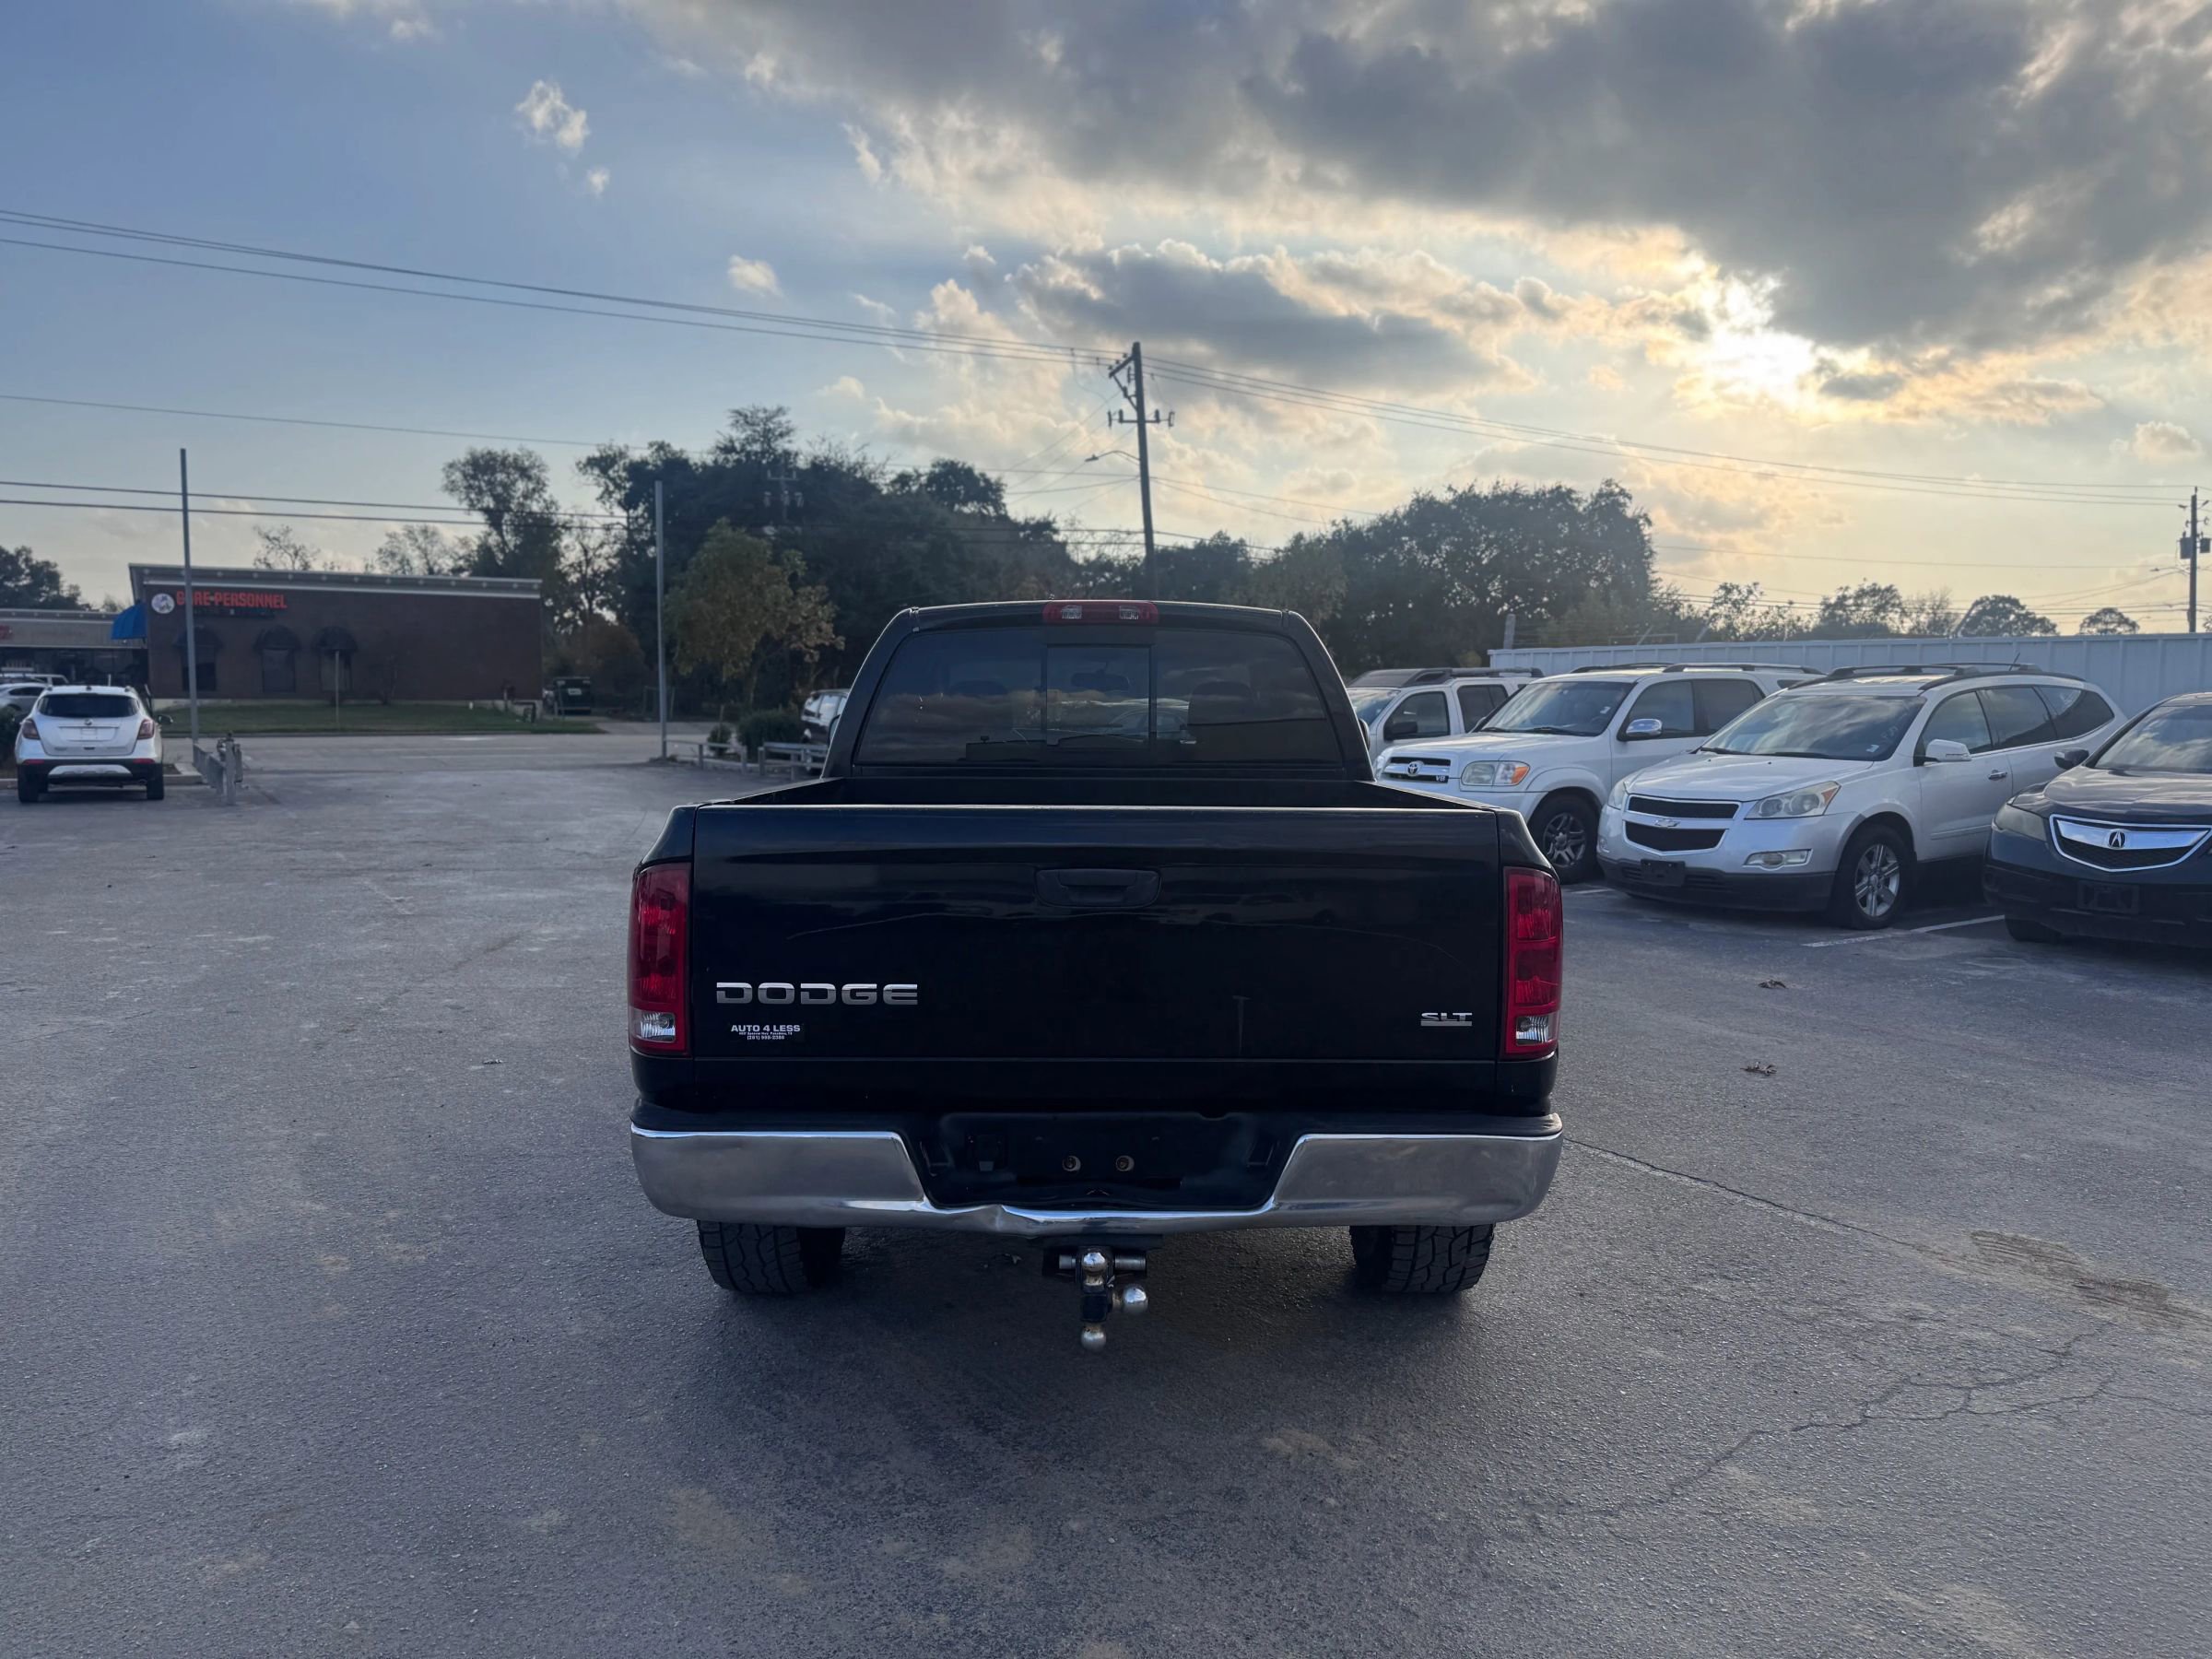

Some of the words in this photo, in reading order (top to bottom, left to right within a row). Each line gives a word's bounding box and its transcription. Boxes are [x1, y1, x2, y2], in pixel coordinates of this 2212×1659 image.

[716, 982, 918, 1006] DODGE
[1421, 1012, 1472, 1023] SLT
[731, 1024, 760, 1032] AUTO
[762, 1024, 771, 1032] 4
[772, 1024, 801, 1032] LESS
